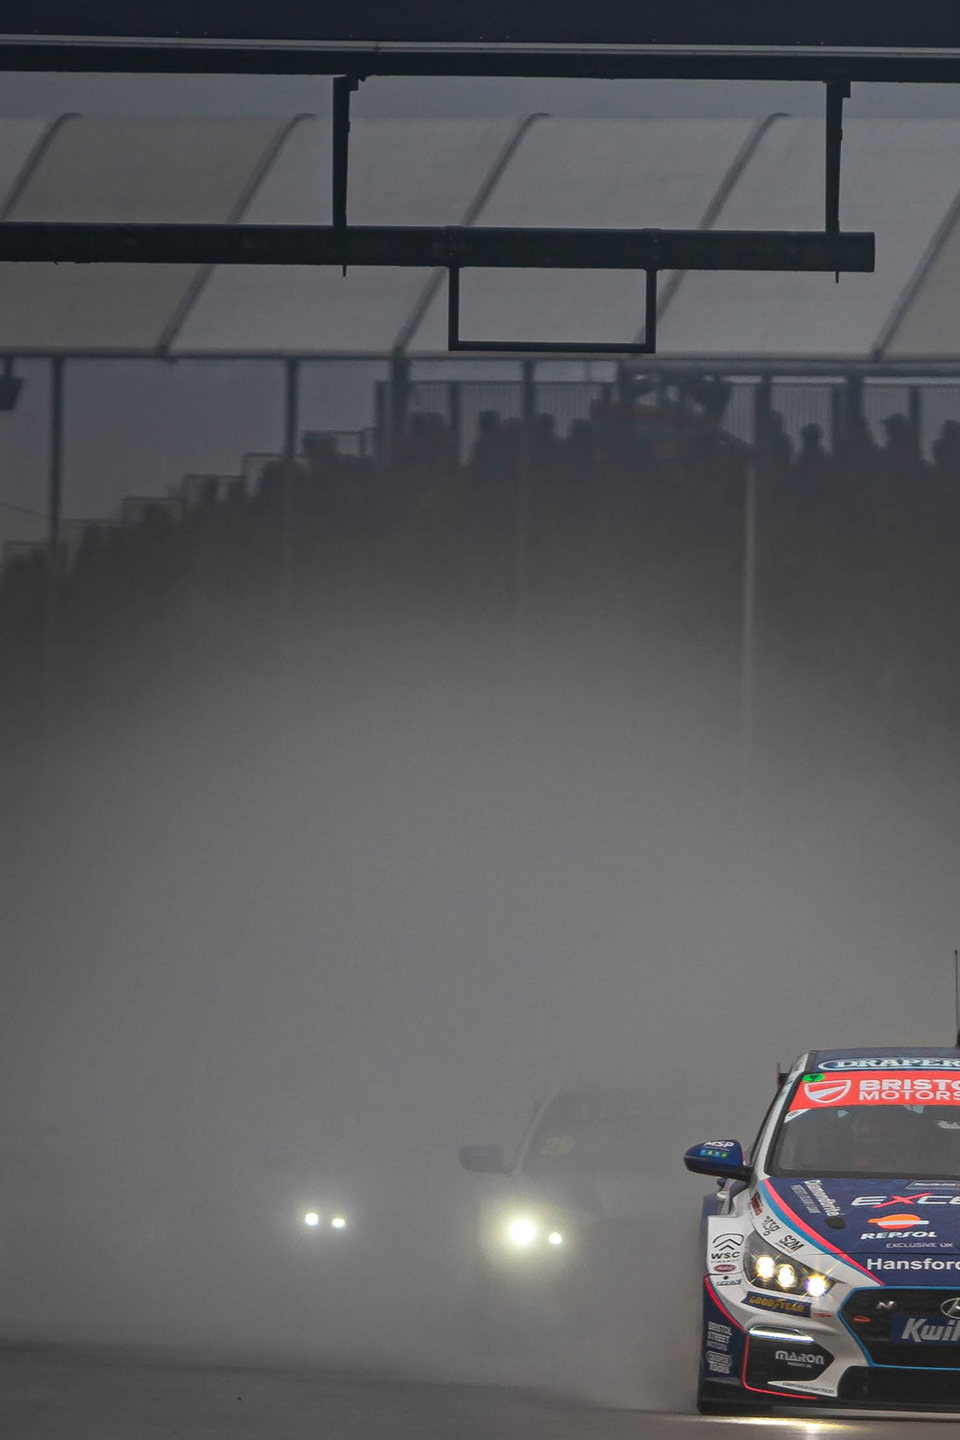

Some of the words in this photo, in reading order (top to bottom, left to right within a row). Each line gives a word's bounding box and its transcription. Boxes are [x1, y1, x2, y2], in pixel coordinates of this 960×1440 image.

[703, 1139, 735, 1148] MSP
[860, 1231, 937, 1240] REPSOL
[711, 1251, 740, 1260] WSC
